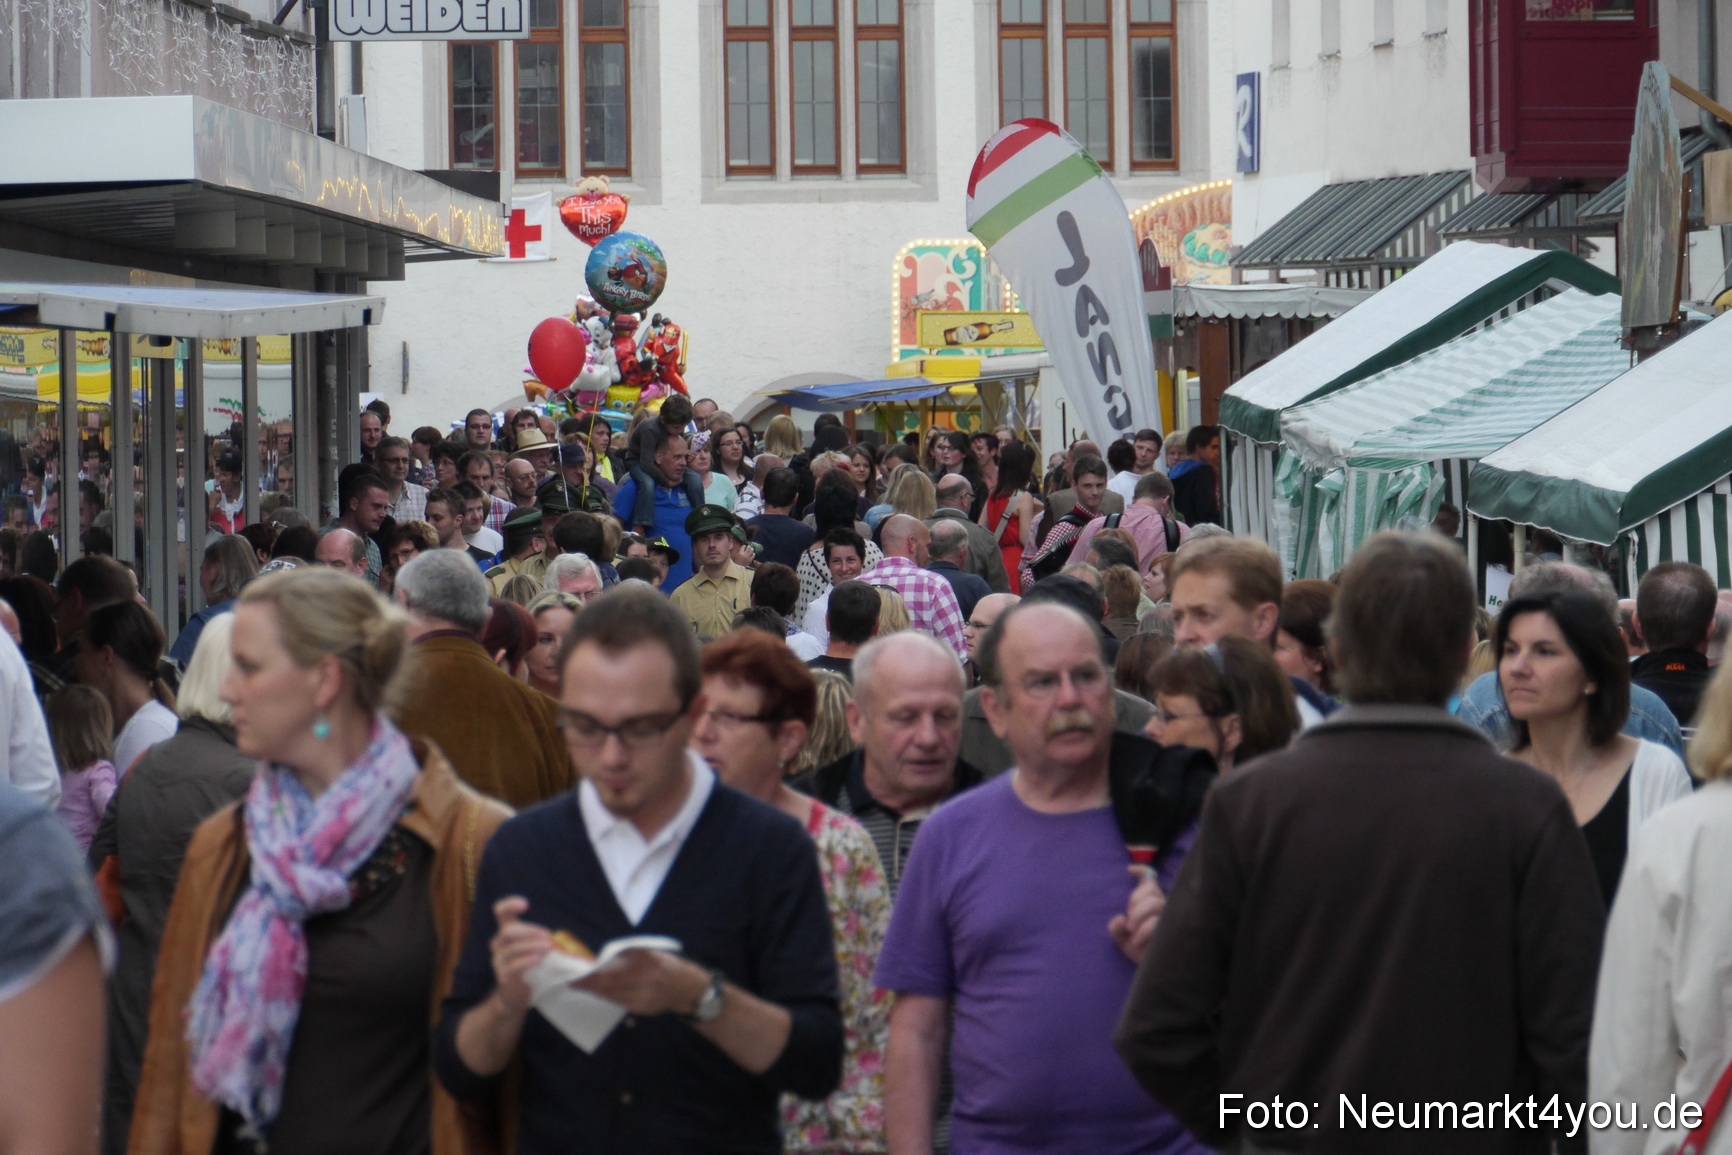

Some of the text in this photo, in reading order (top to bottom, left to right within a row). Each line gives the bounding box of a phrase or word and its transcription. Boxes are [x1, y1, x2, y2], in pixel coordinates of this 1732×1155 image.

[334, 0, 522, 35] WEIDEN
[568, 197, 576, 206] I
[574, 205, 611, 224] This
[1488, 595, 1504, 607] Ho
[1665, 663, 1685, 671] KTM
